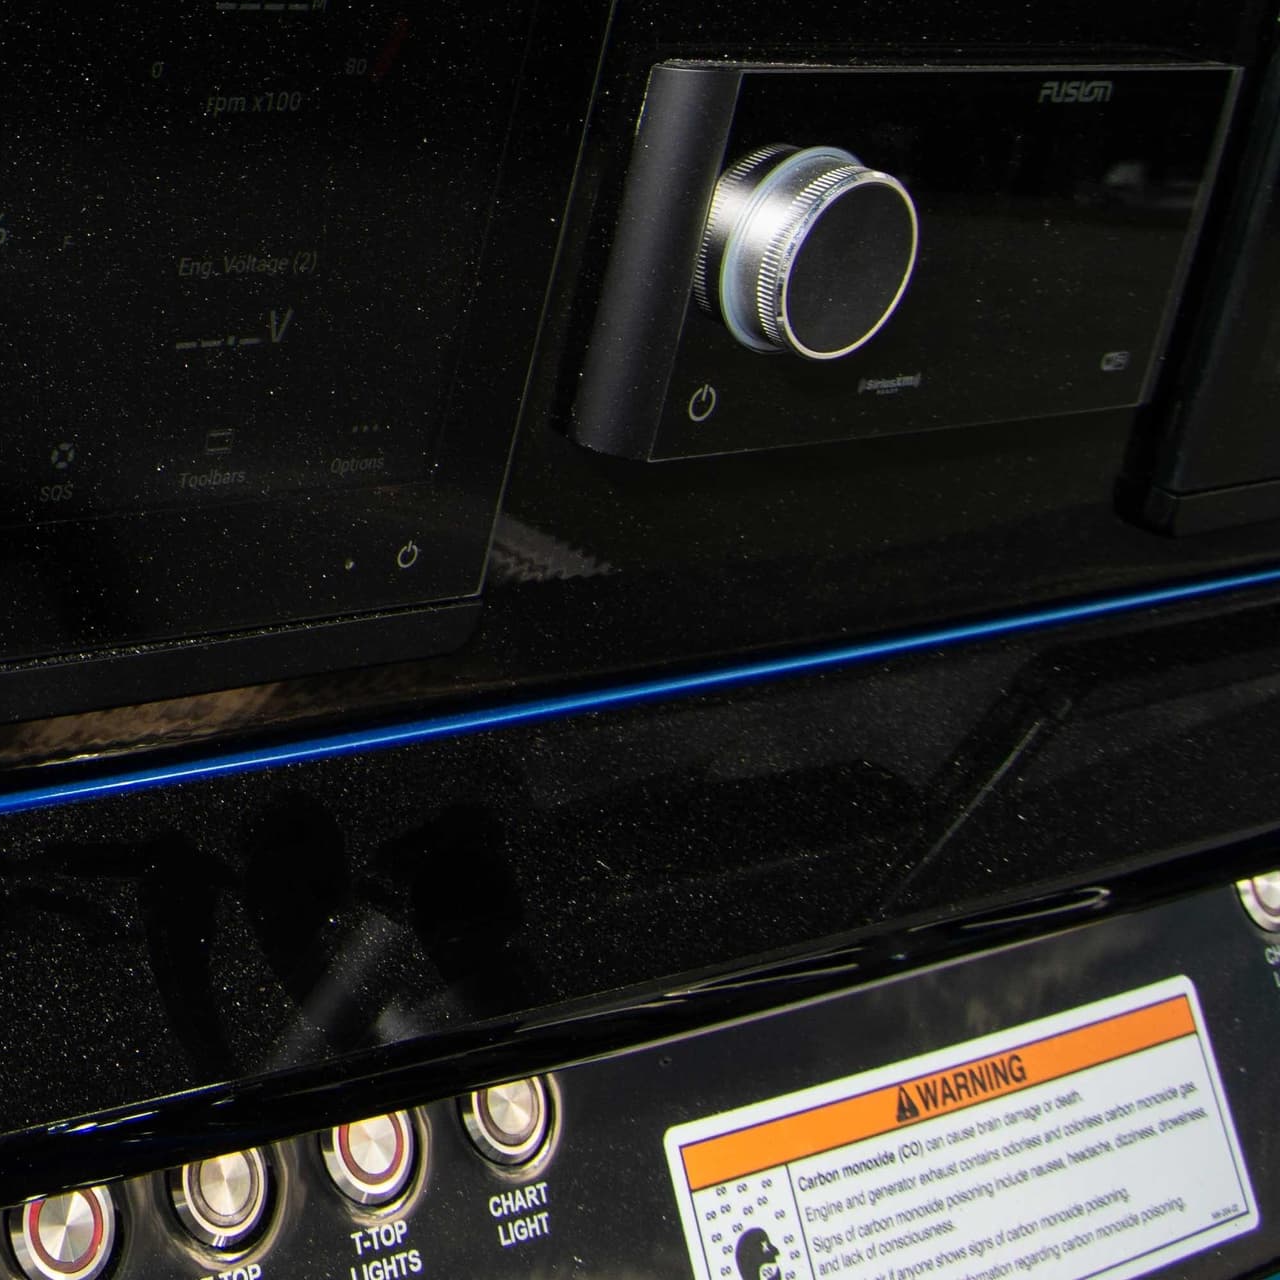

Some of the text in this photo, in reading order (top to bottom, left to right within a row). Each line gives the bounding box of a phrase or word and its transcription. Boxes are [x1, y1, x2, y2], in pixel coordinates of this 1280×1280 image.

[206, 94, 247, 118] rpm
[1038, 80, 1114, 104] FUSION
[177, 257, 218, 280] Eng.
[223, 255, 289, 275] Voltage
[178, 469, 246, 490] Toolbars
[329, 455, 385, 477] Options
[916, 1054, 1028, 1112] WARNING
[798, 1169, 840, 1192] Carbon
[842, 1150, 896, 1178] monoxide
[898, 1139, 924, 1163] (CO)
[926, 1136, 945, 1152] can
[946, 1126, 976, 1146] cause
[976, 1117, 1002, 1135] brain
[804, 1200, 844, 1222] Engine
[846, 1191, 866, 1210] and
[868, 1176, 916, 1207] generator
[919, 1162, 958, 1186] exhaust
[959, 1149, 1001, 1172] contains
[1043, 1125, 1062, 1144] and
[1104, 1102, 1135, 1123] carbon
[488, 1182, 549, 1218] CHART
[812, 1229, 844, 1255] Signs
[845, 1224, 856, 1242] of
[858, 1215, 895, 1238] carbon
[895, 1199, 945, 1225] monoxide
[945, 1182, 995, 1212] poisoning
[994, 1170, 1029, 1191] include
[350, 1221, 409, 1256] T-TOP
[498, 1213, 552, 1248] LIGHT
[935, 1247, 967, 1268] shows
[968, 1237, 994, 1258] signs
[994, 1229, 1005, 1246] of
[1006, 1220, 1039, 1243] carbon
[1039, 1202, 1085, 1229] monoxide
[1014, 1244, 1061, 1272] regarding
[1061, 1232, 1094, 1254] carbon
[1095, 1213, 1140, 1240] monoxide
[350, 1250, 424, 1280] LIGHTS
[817, 1254, 841, 1277] and
[841, 1247, 864, 1269] lack
[865, 1241, 877, 1260] of
